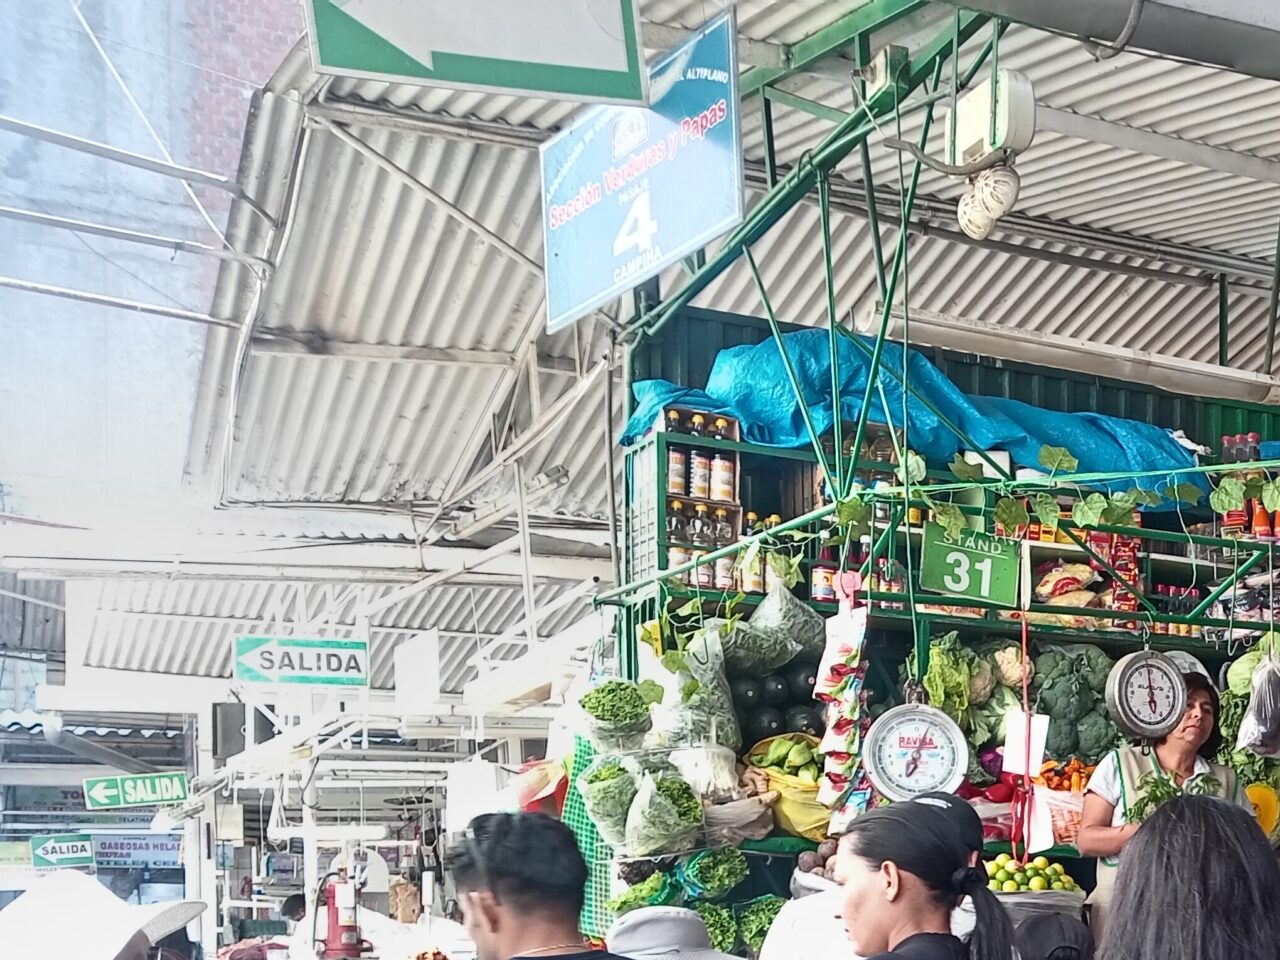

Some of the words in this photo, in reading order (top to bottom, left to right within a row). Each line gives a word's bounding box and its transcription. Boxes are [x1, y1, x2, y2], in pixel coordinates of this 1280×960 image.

[686, 67, 729, 84] ALTIPLANO
[550, 180, 602, 230] Sección
[603, 139, 667, 194] Verduras
[665, 130, 679, 160] y
[678, 98, 728, 147] Papas
[612, 192, 660, 257] 4
[943, 530, 1002, 554] STAND
[943, 551, 992, 597] 31
[259, 650, 362, 674] SALIDA
[123, 776, 185, 803] SALIDA
[41, 841, 89, 856] SALIDA
[100, 842, 150, 851] GASEOSAS
